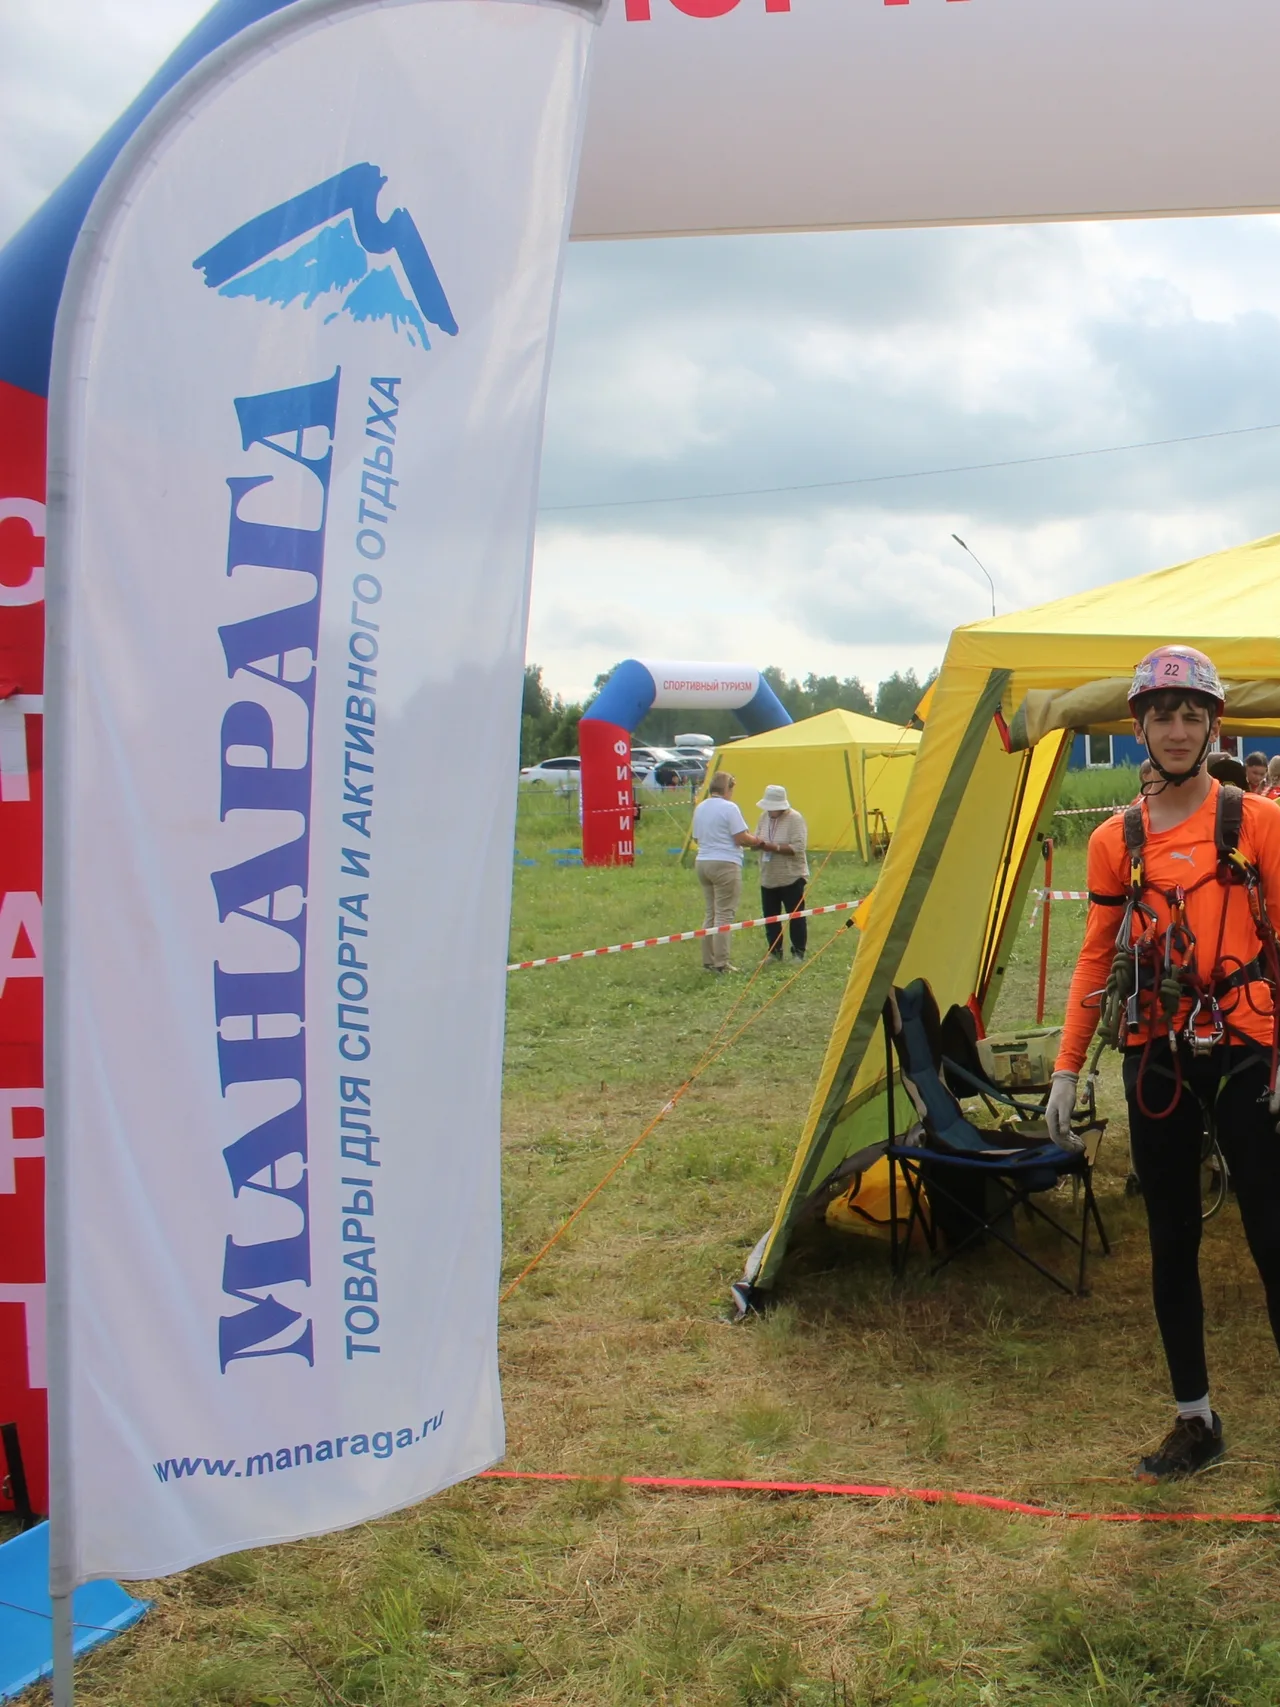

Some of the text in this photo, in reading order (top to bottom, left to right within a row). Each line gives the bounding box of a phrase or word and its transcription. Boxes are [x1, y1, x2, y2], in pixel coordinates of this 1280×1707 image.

[663, 679, 752, 691] СПОРТИВНЫЙ ТУРИЗМ
[1164, 663, 1180, 677] 22
[613, 740, 633, 856] ФИНИШ
[211, 366, 342, 1375] МАНАРАГА
[336, 376, 403, 1361] ТОВАРЫ ДЛЯ СПОРТА И АКТИВНОГО ОТДЫХА
[153, 1409, 445, 1483] www.manaraga.ru
